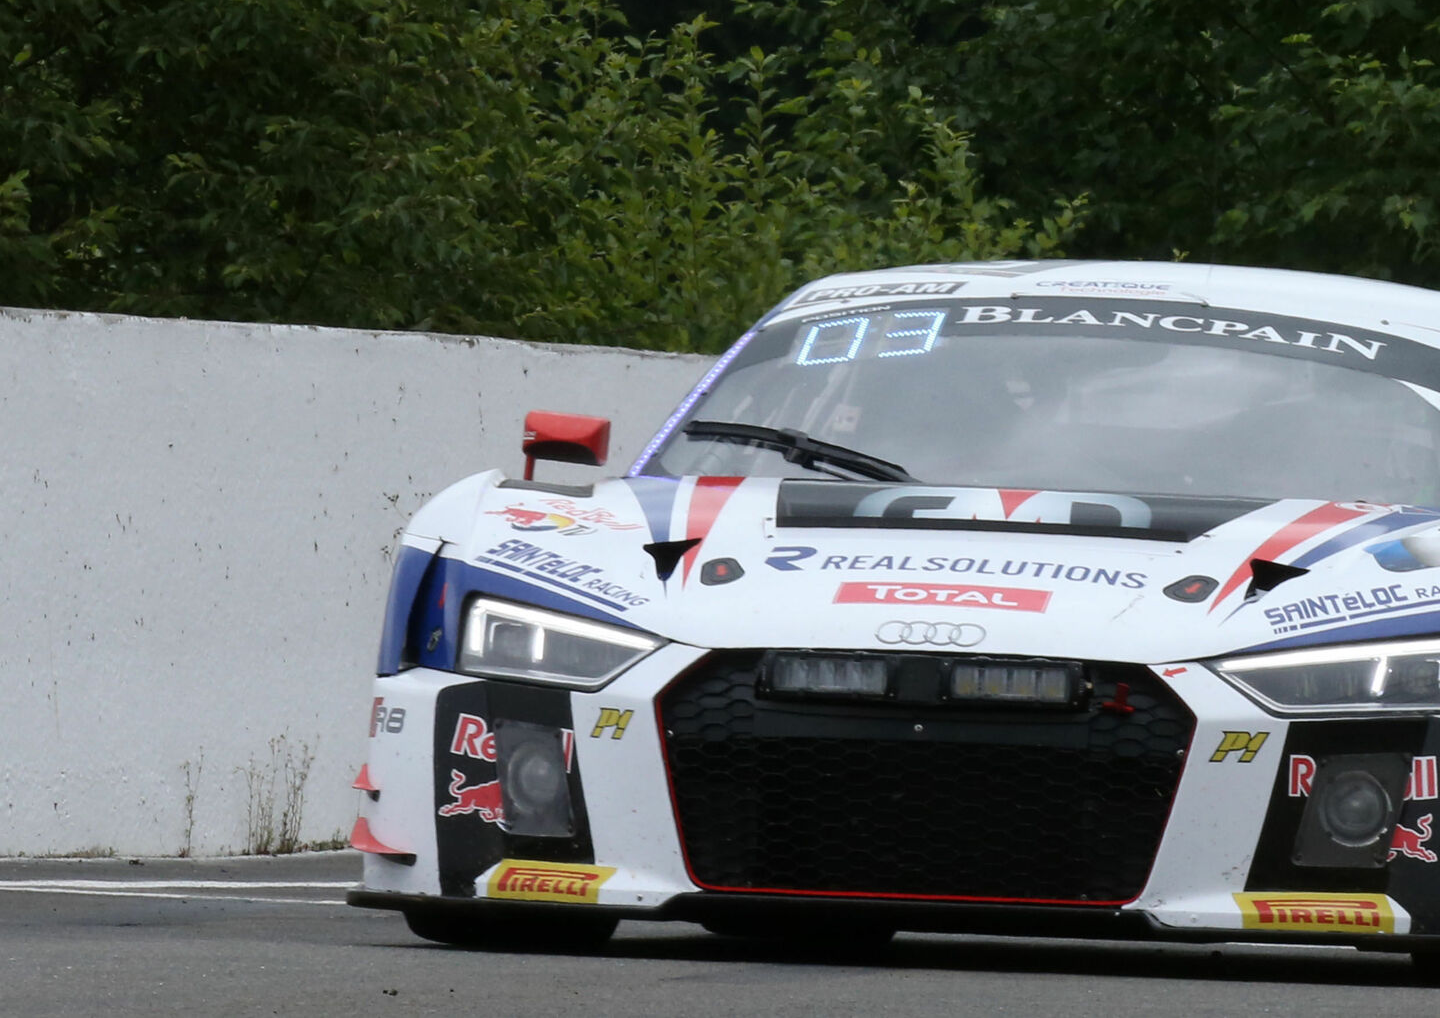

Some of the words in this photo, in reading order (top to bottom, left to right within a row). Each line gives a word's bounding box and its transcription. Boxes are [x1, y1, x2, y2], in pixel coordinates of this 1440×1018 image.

[806, 282, 956, 301] PRO-AM
[796, 311, 946, 366] 03
[955, 305, 1388, 361] BLANCPAIN
[820, 555, 1149, 589] REALSOLUTIONS
[583, 579, 650, 607] RACING
[867, 584, 1019, 607] TOTAL
[450, 713, 498, 762] Re
[497, 867, 599, 897] PIRELLI
[1251, 899, 1380, 927] PIRELLI
